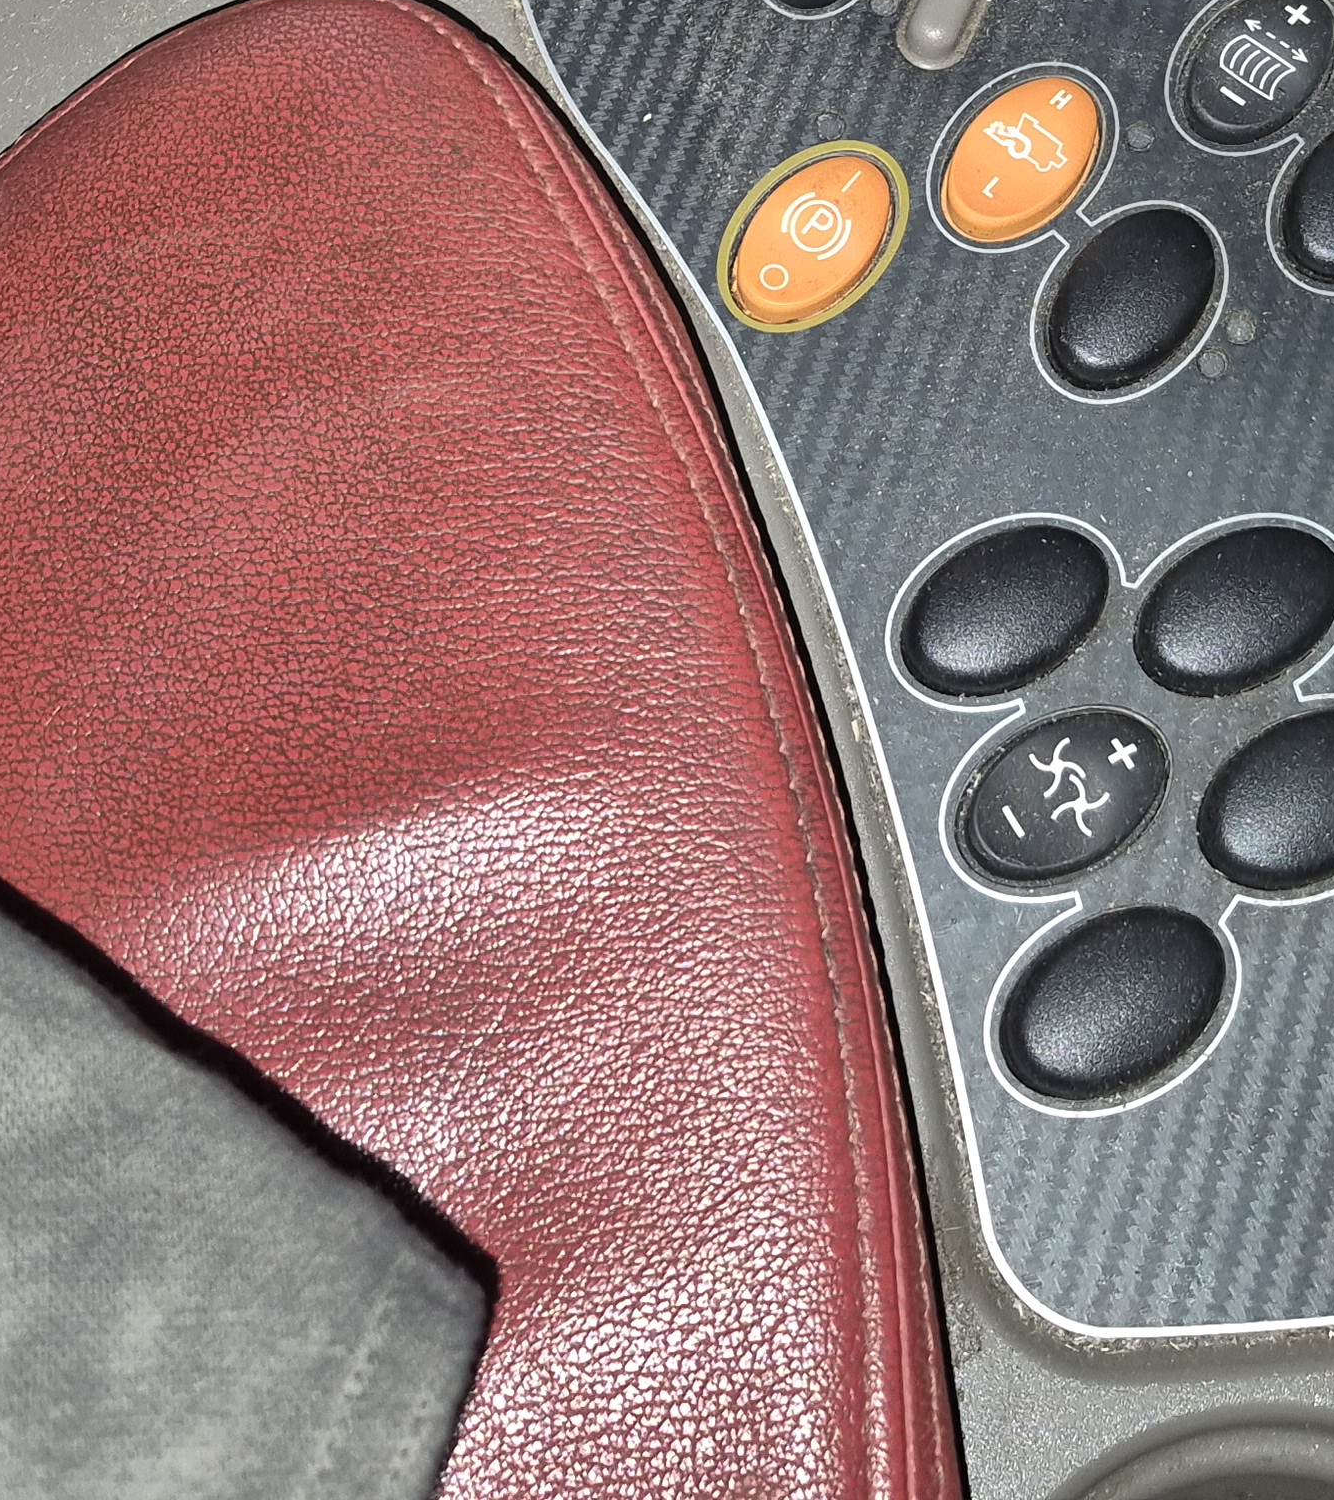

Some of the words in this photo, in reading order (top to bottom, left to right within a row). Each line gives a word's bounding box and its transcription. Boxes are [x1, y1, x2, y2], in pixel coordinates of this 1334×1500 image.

[1050, 89, 1073, 109] H
[982, 177, 1000, 198] L
[801, 208, 833, 235] P
